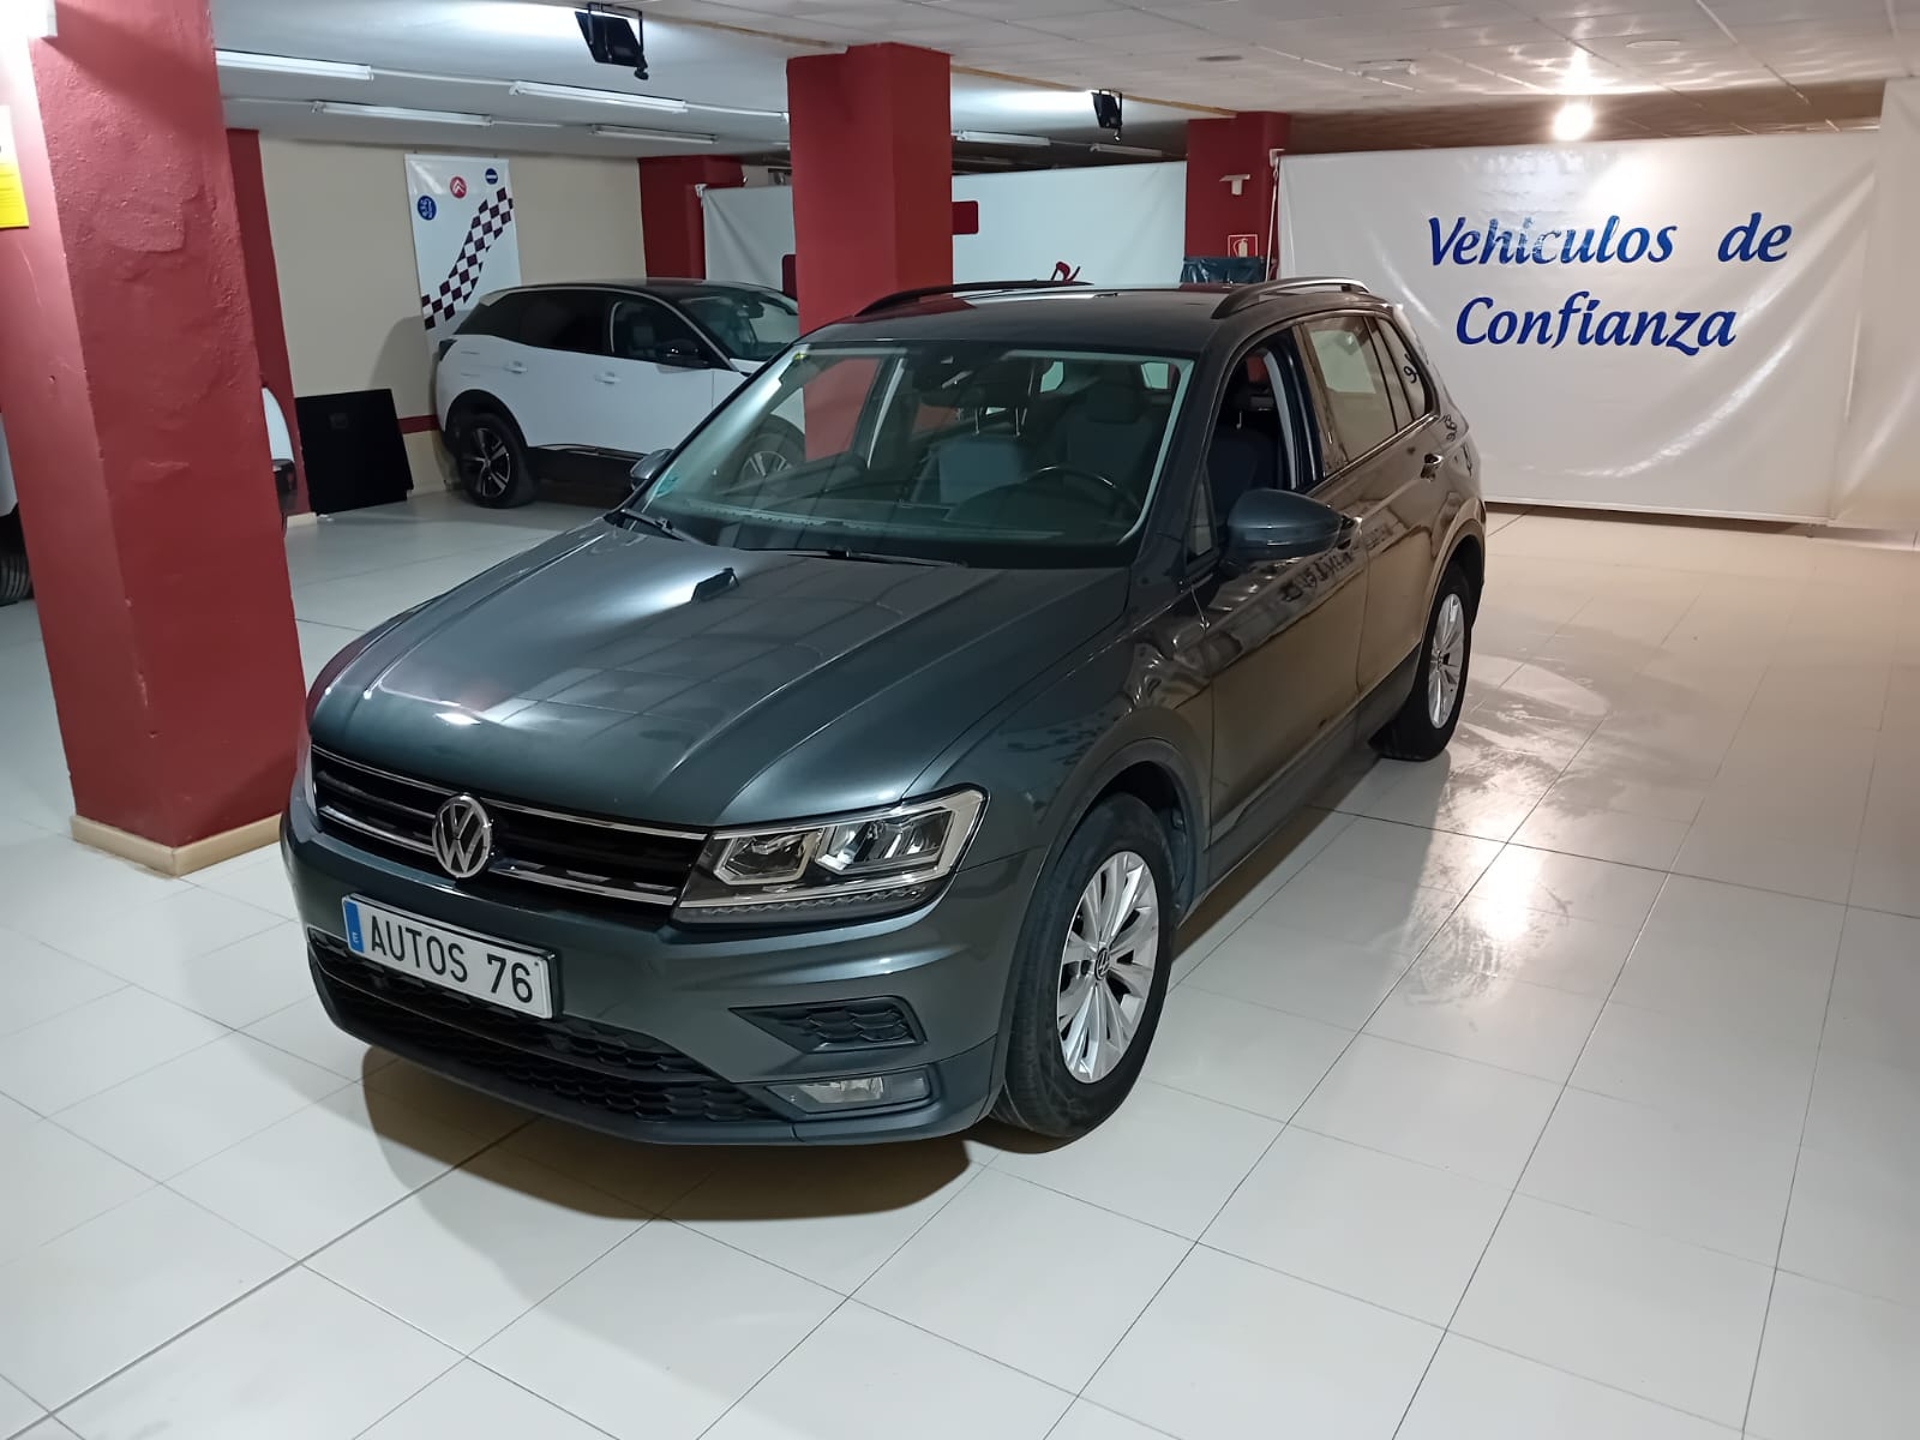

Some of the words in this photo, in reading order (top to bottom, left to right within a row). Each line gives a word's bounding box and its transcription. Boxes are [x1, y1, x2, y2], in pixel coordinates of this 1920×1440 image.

[1717, 212, 1792, 262] de
[1456, 290, 1737, 356] Confianza
[371, 915, 468, 983] AUTOS
[487, 953, 533, 1004] 76
